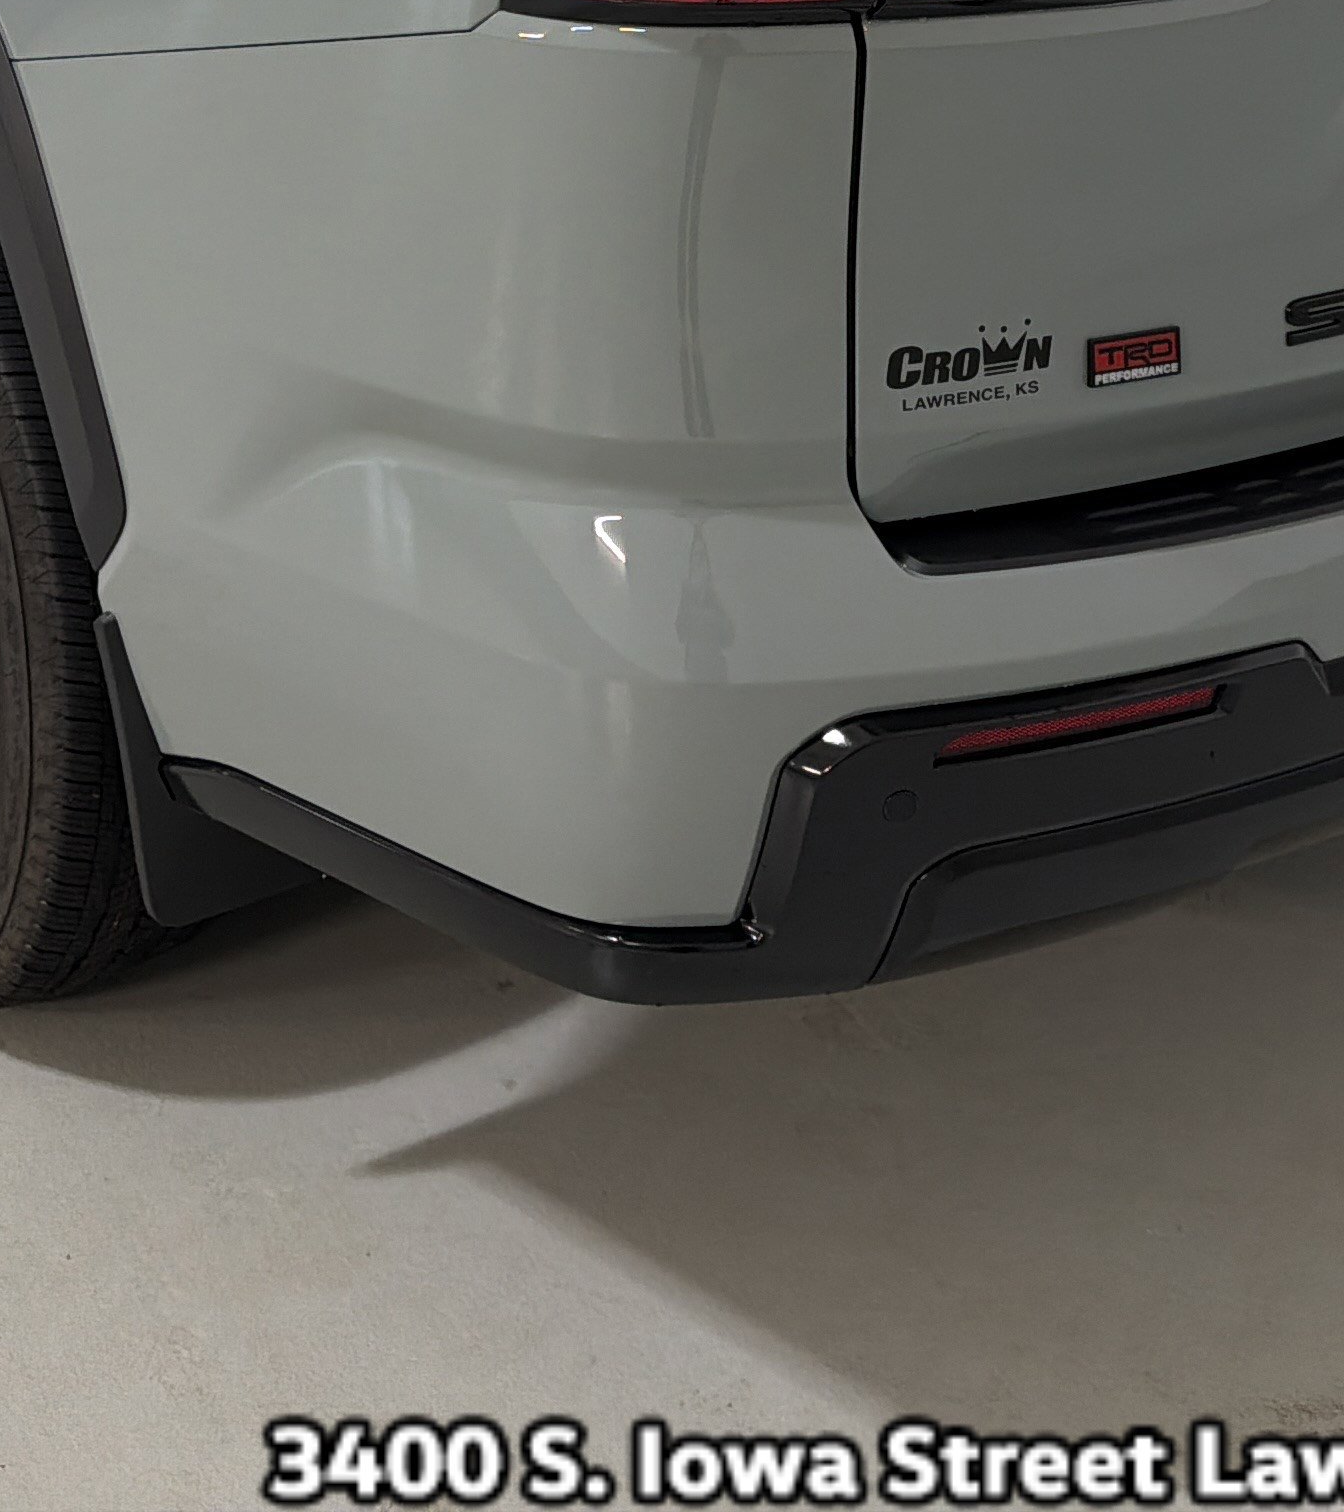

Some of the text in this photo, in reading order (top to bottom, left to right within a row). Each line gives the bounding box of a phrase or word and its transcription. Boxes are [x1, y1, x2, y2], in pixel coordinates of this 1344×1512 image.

[1098, 338, 1173, 369] TRD
[1094, 362, 1179, 386] PERFORMANCE
[902, 380, 1040, 412] LAWRENCE, KS
